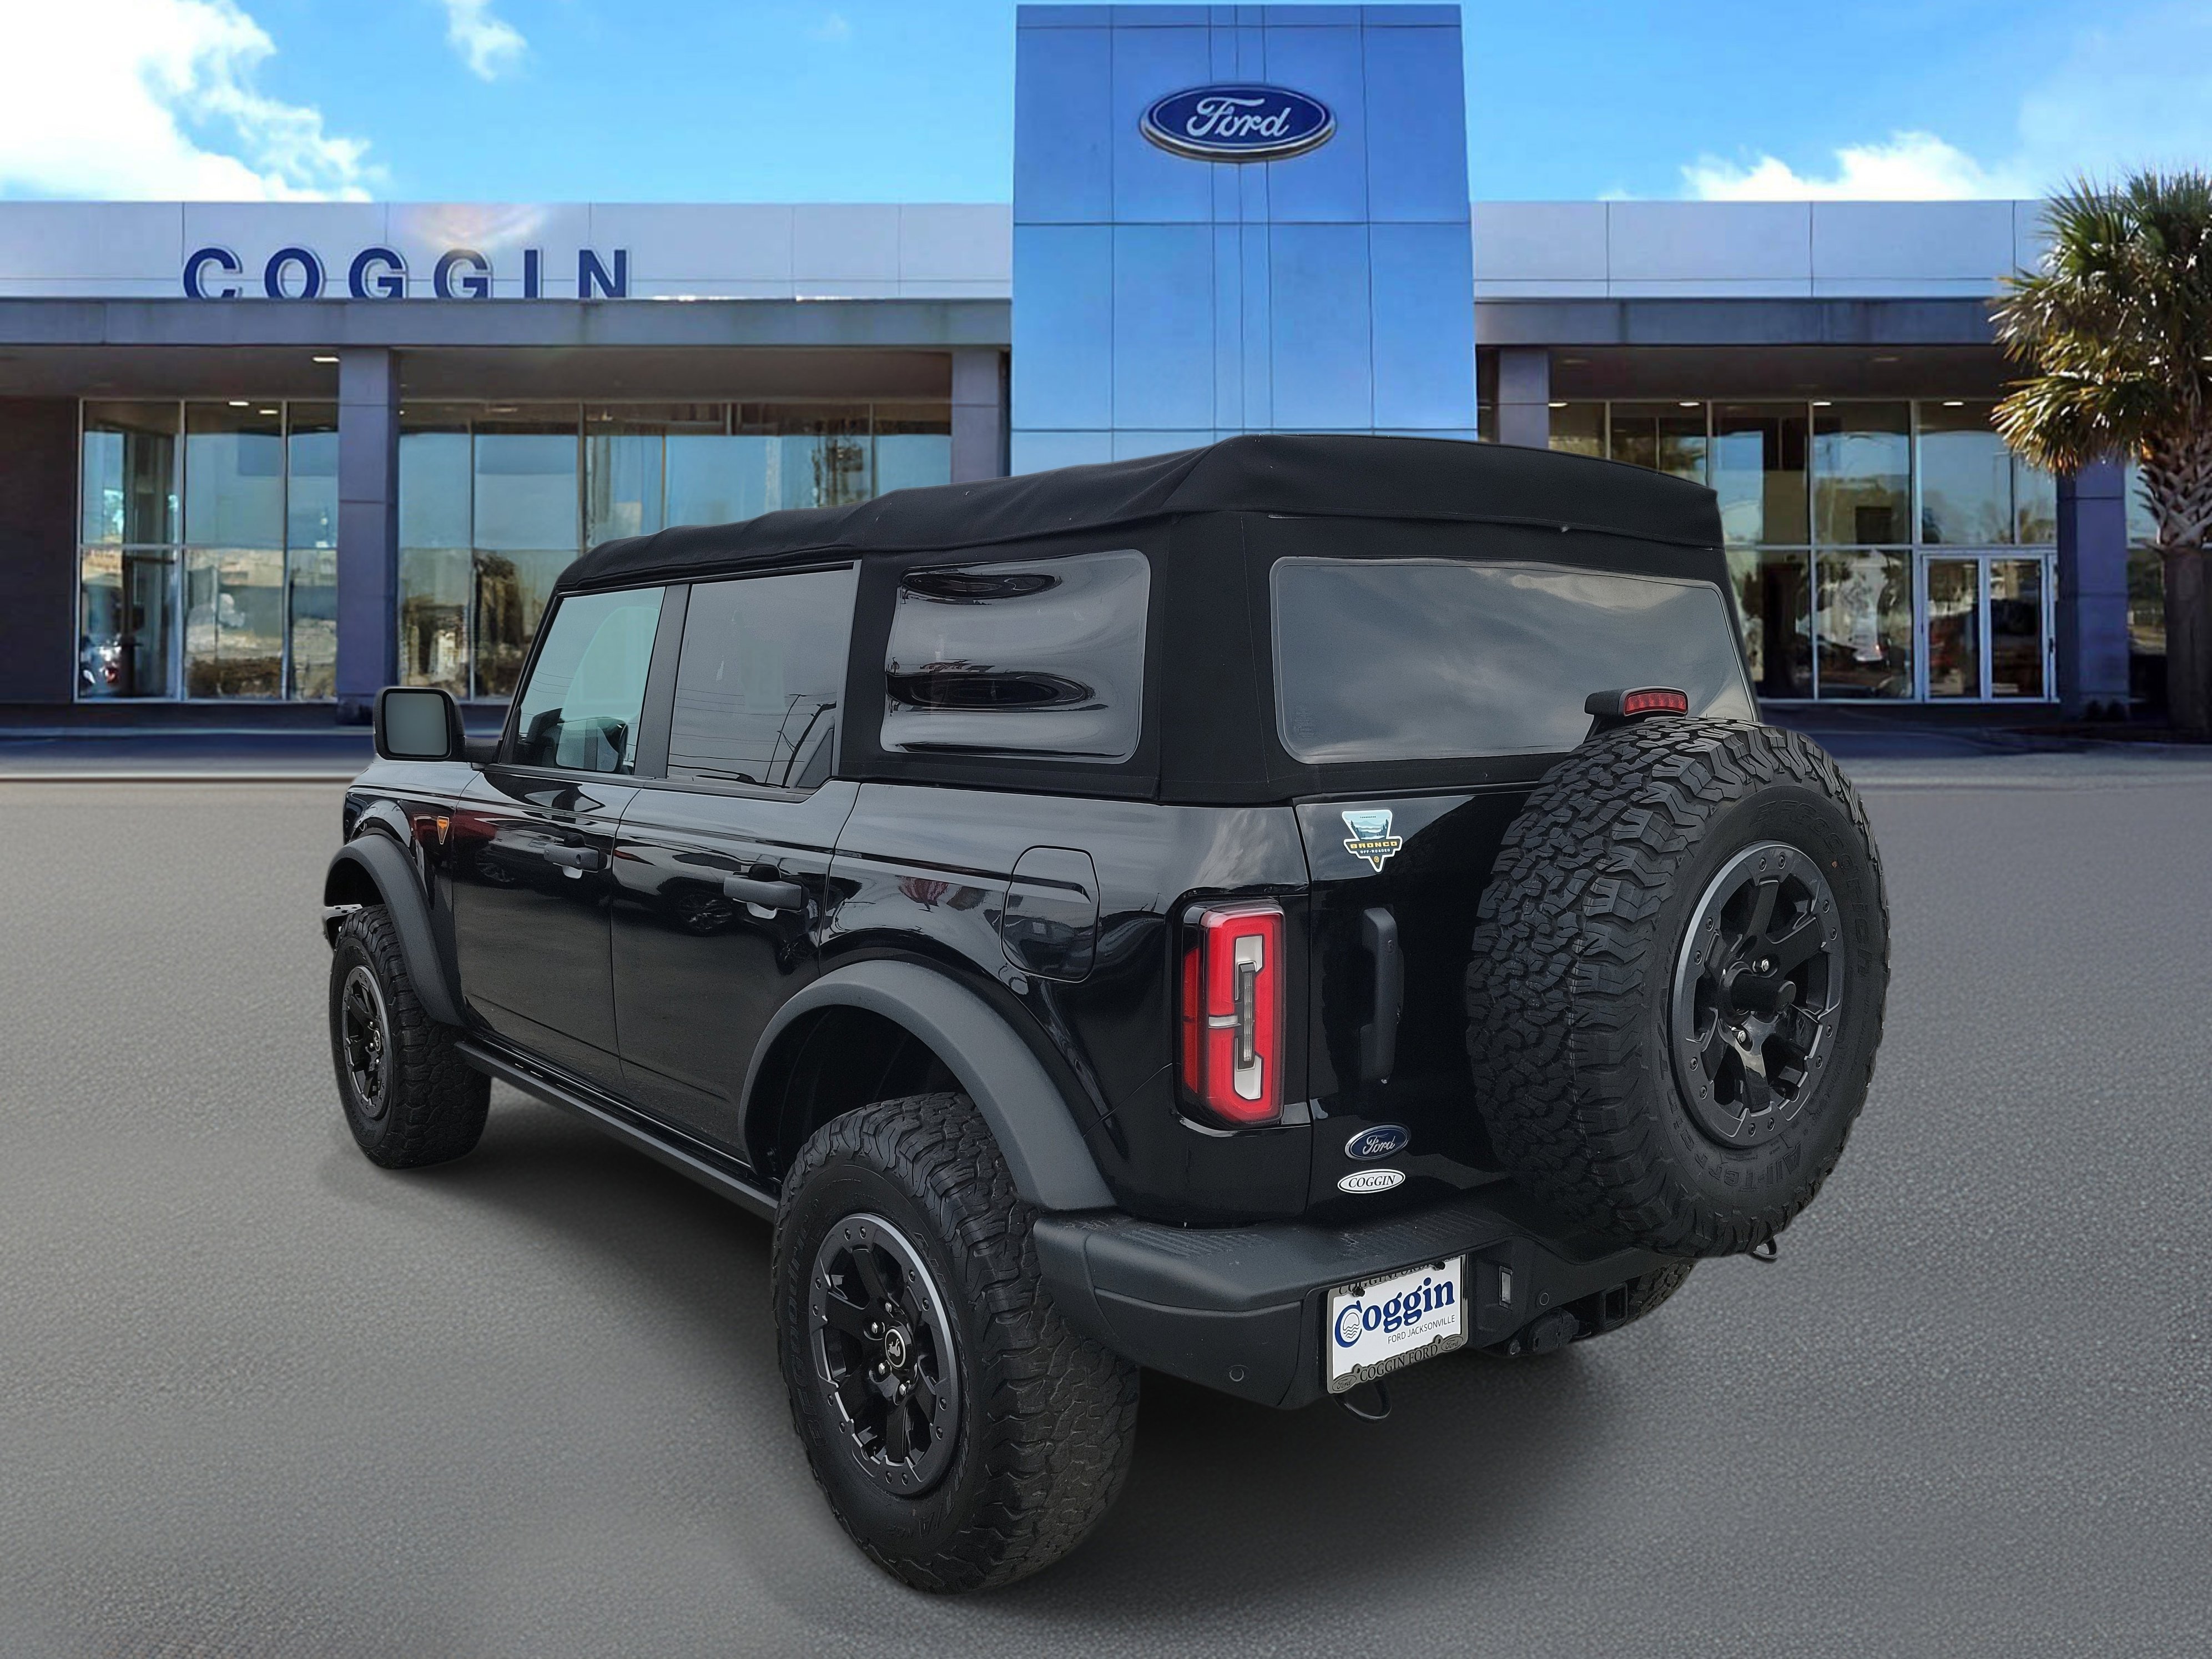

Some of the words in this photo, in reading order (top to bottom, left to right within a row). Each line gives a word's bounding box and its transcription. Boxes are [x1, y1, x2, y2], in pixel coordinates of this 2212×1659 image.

[1186, 97, 1292, 137] Ford
[183, 247, 629, 299] COGGIN
[1362, 1133, 1396, 1155] Ford
[1348, 1175, 1396, 1188] COGGIN
[1334, 1277, 1455, 1348] Coggin
[1388, 1329, 1406, 1345] FORD
[1407, 1314, 1455, 1338] JACKSONVILLE
[1360, 1354, 1405, 1381] COGGIN
[1409, 1343, 1439, 1365] FORD
[1336, 1379, 1351, 1390] Ford
